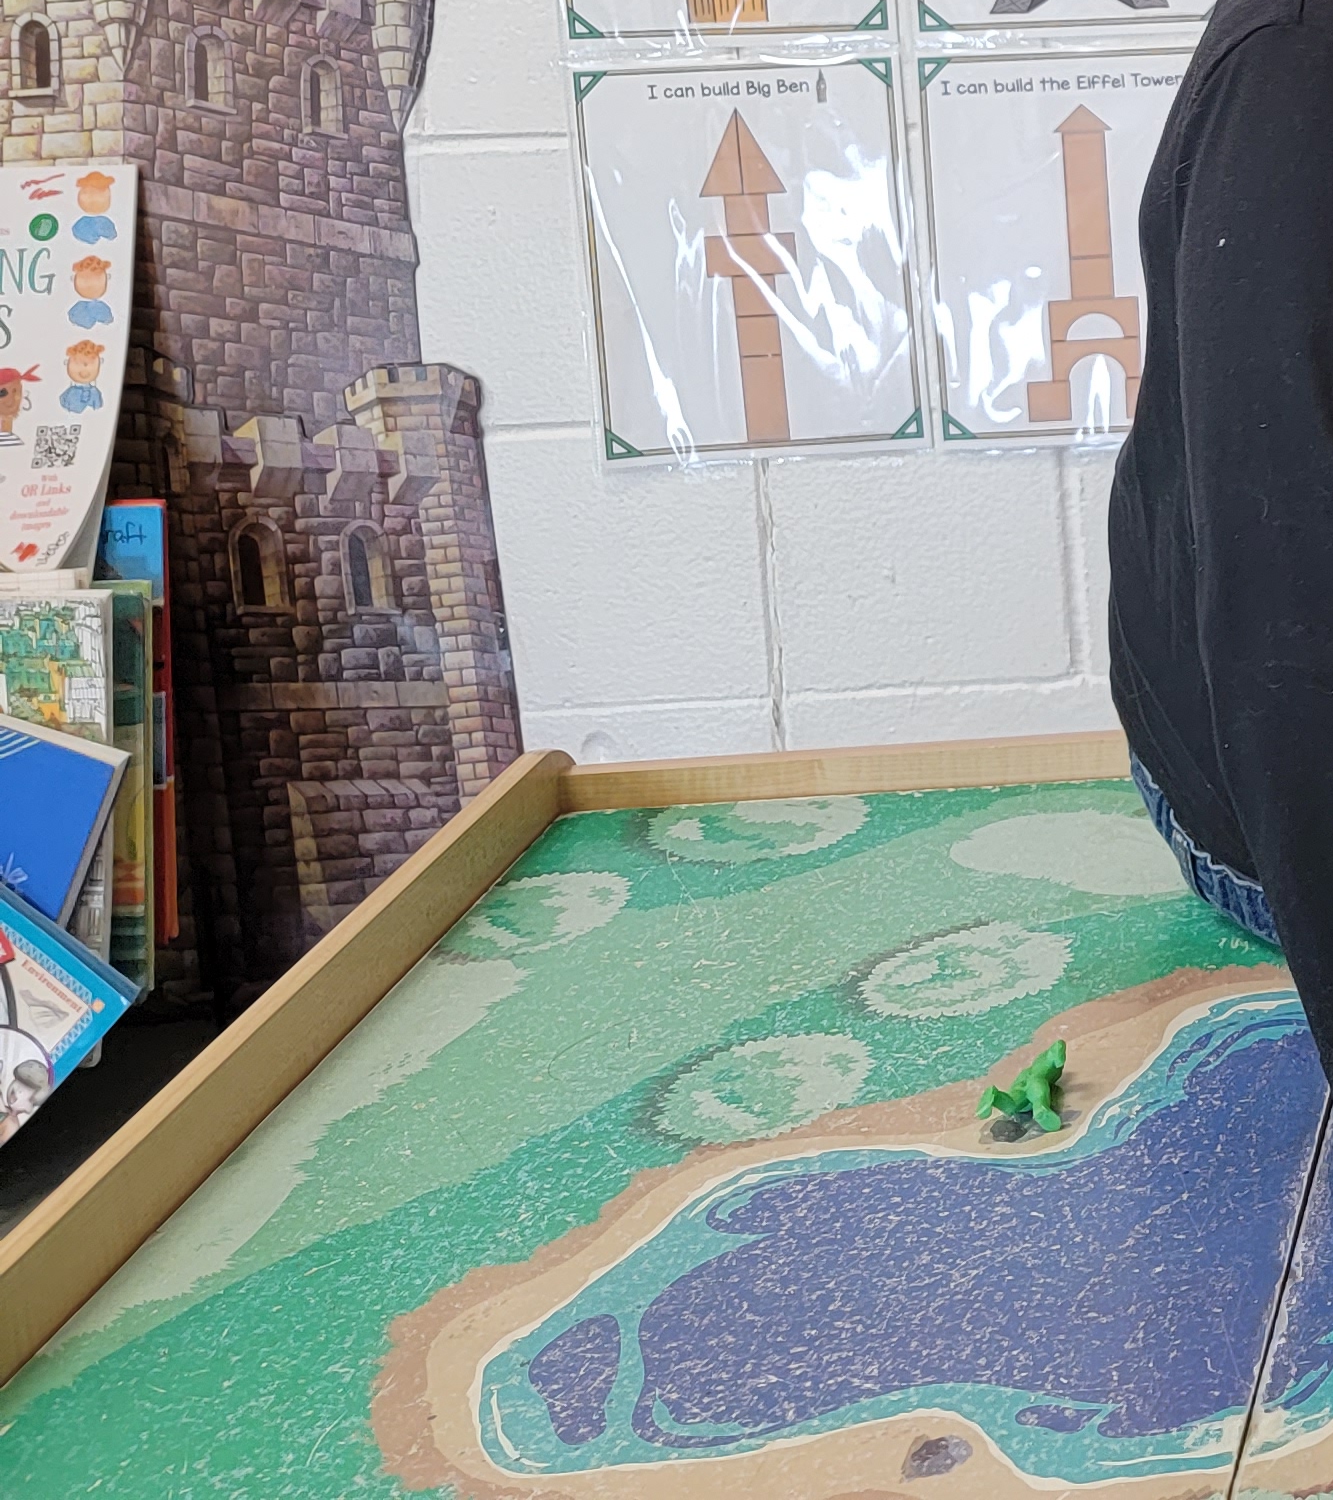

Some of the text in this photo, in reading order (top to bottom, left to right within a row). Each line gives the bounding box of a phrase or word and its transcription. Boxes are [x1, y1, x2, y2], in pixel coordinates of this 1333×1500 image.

[647, 79, 810, 99] I can build Big Ben
[941, 73, 1182, 95] I can build the Eiffel Tower
[21, 482, 71, 498] QR Links
